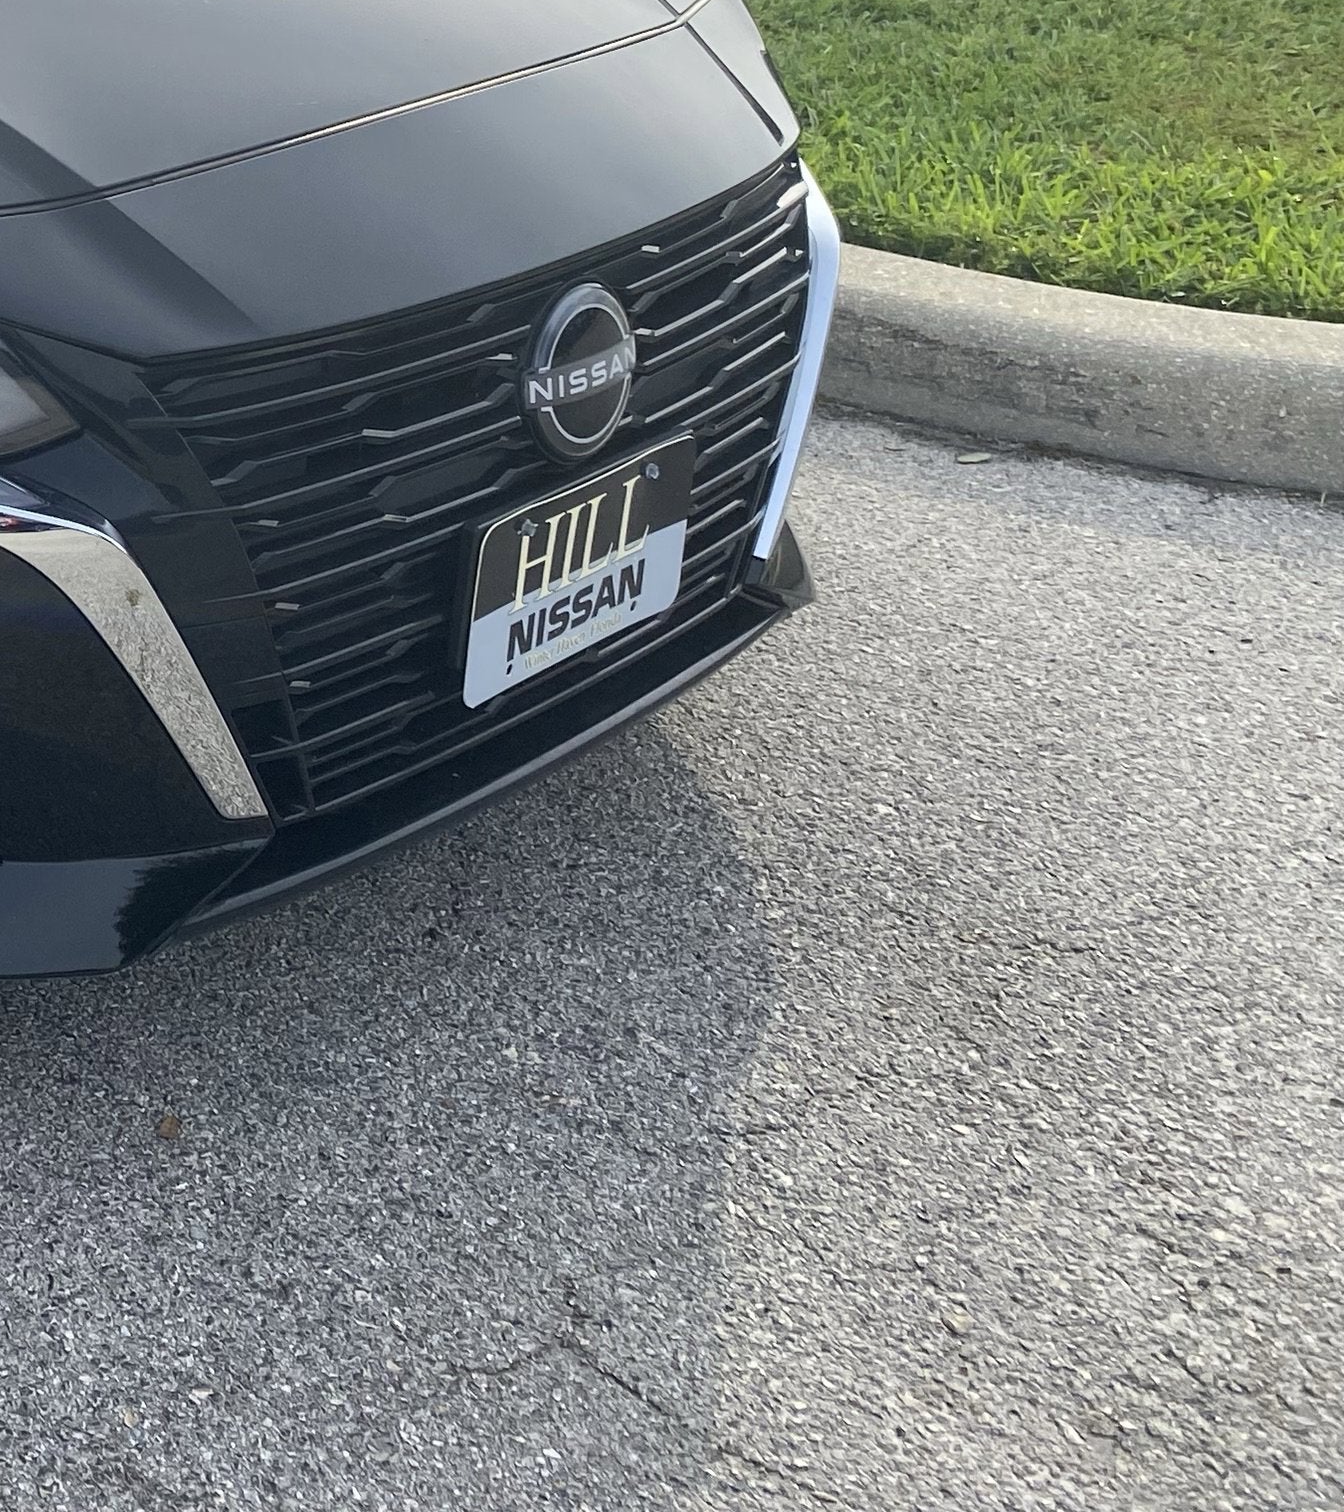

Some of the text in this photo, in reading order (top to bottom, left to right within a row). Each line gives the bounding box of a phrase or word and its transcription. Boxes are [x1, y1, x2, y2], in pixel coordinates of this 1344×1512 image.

[528, 346, 636, 404] NISSAN
[508, 474, 650, 615] HILL
[506, 557, 646, 663] NISSAN
